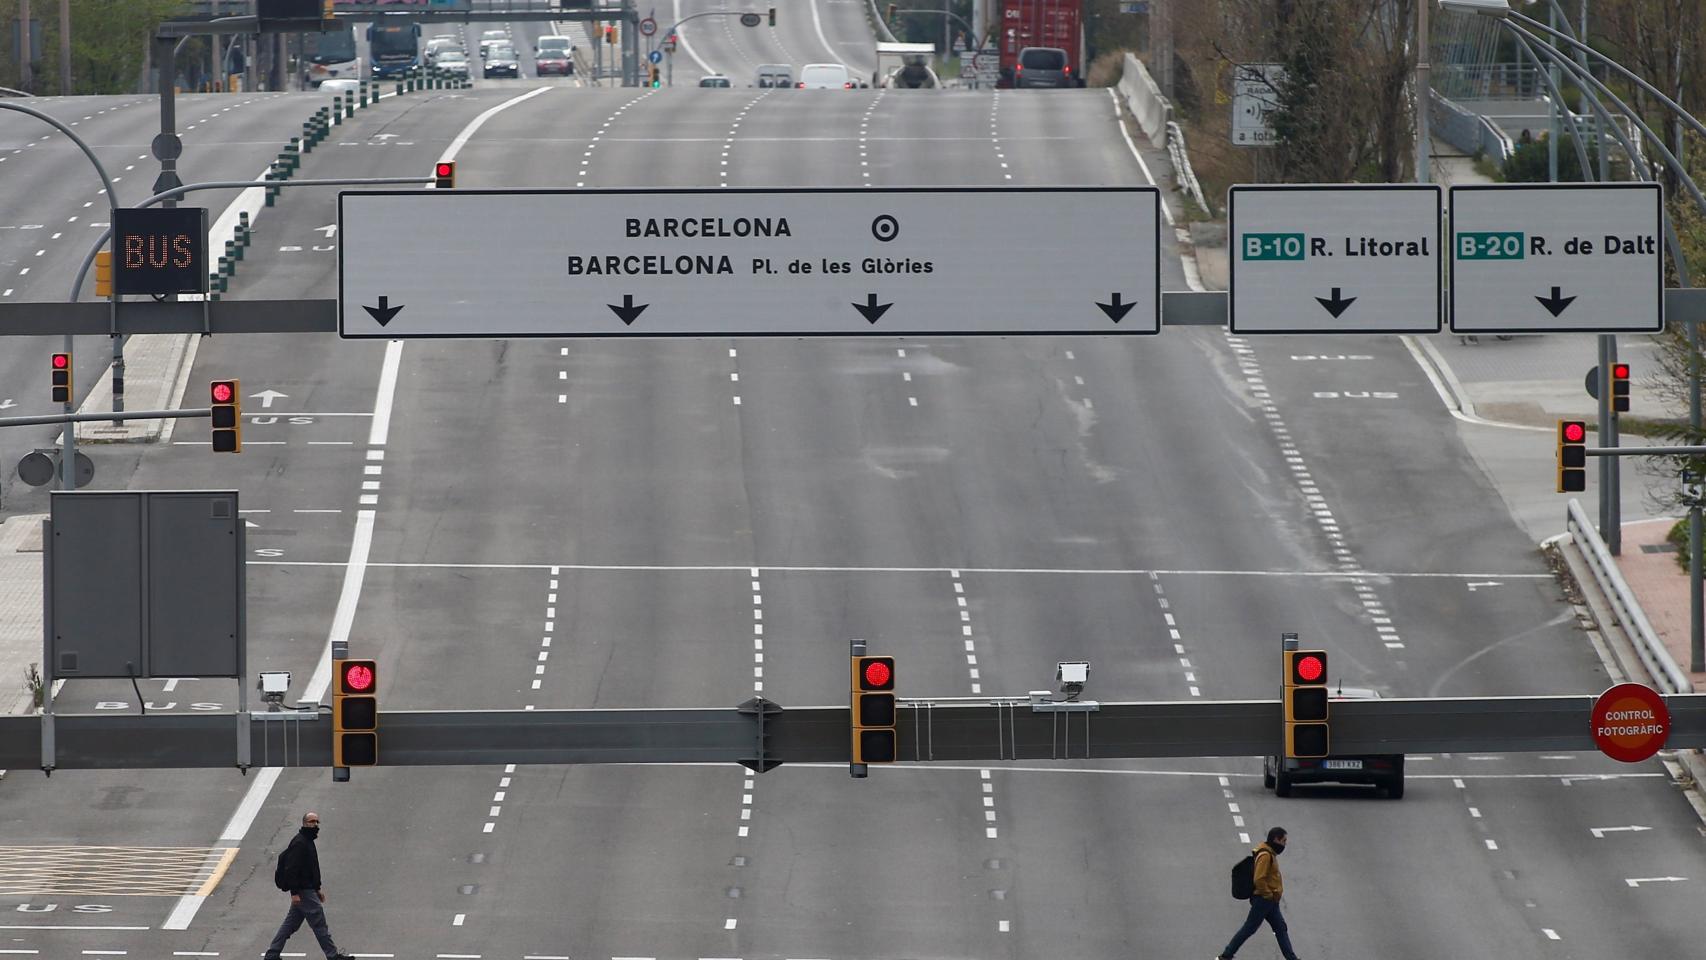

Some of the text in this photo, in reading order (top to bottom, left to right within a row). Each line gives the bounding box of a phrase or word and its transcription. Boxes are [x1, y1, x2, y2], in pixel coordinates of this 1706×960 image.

[625, 217, 792, 238] BARCELONA
[124, 233, 192, 268] BUS
[1246, 237, 1430, 257] B-10 R. Litoral
[1460, 235, 1655, 256] B-20 R. de Dalt
[567, 255, 934, 275] BARCELONA Pl. de les Glòries
[250, 416, 314, 425] US
[95, 701, 223, 711] BUS
[1605, 710, 1655, 721] CONTROL
[1597, 723, 1663, 737] FOTOGRÀFIC
[16, 903, 113, 913] US
